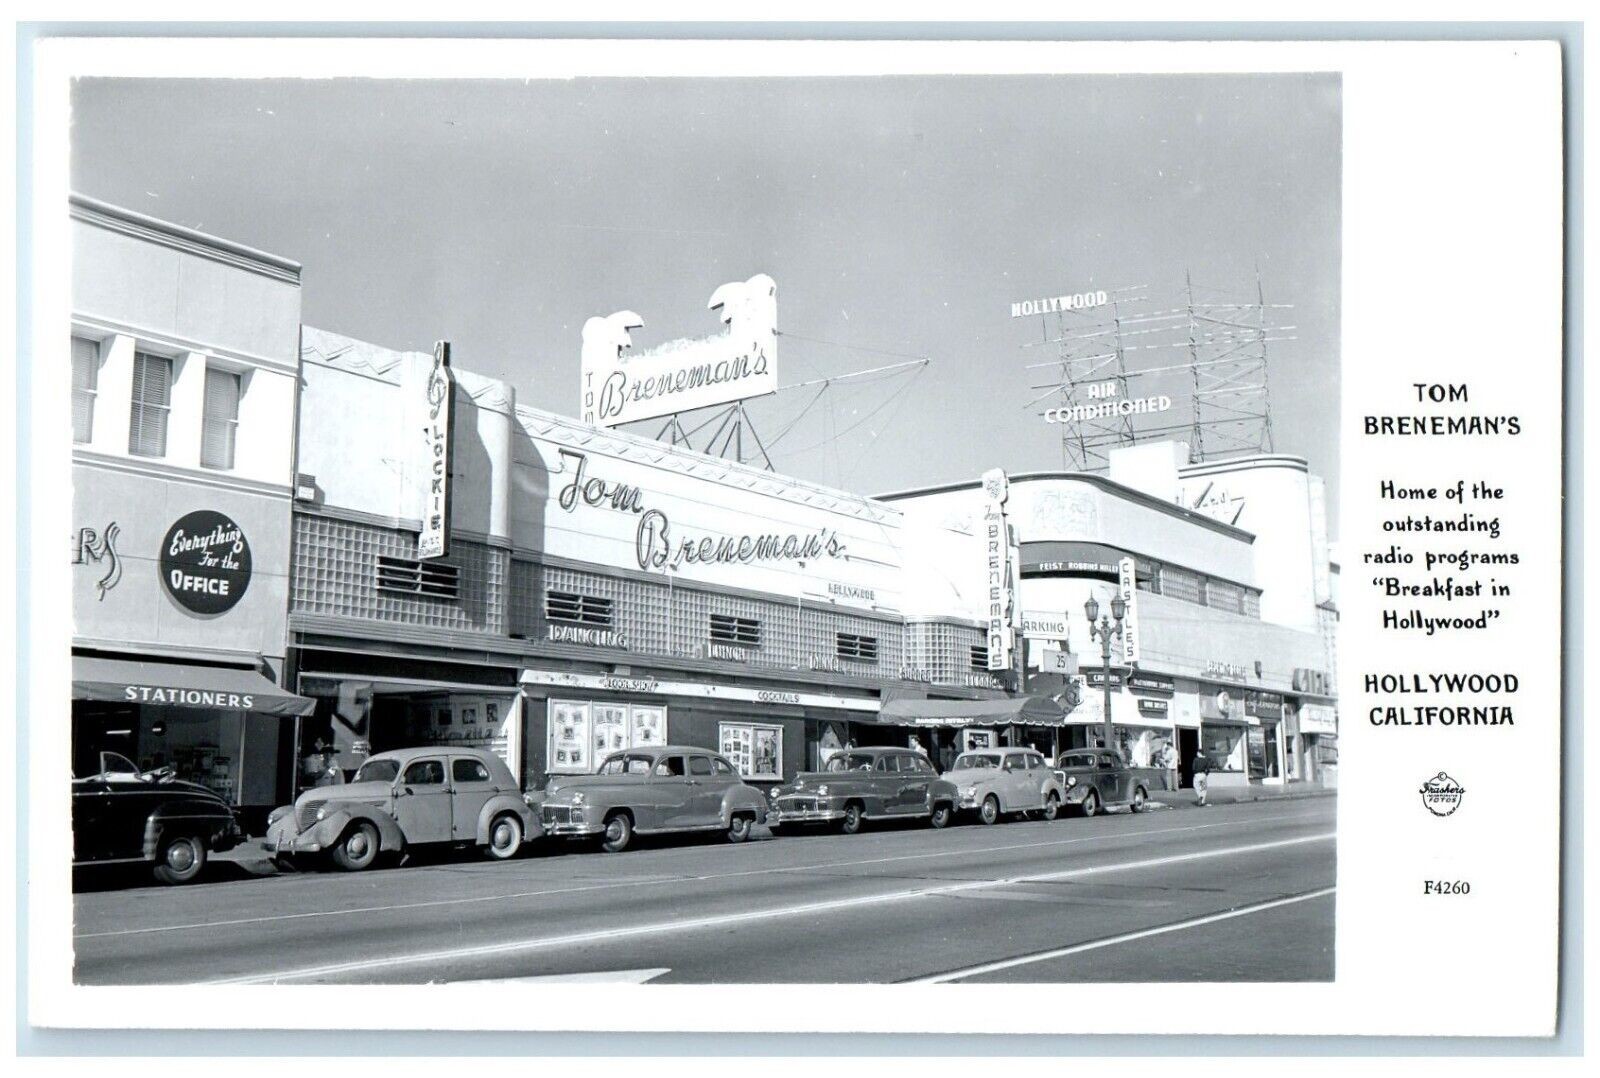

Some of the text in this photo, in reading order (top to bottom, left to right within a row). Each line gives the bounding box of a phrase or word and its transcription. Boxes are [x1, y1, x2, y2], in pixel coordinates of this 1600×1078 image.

[1011, 290, 1108, 318] HOLLYWOOD
[599, 341, 768, 420] Breneman's
[1087, 381, 1117, 400] AIR
[1044, 396, 1171, 424] CONDITIONED
[558, 447, 644, 514] Tom
[169, 523, 243, 557] Everything
[636, 508, 845, 570] Breneman's
[71, 521, 122, 601] RS
[198, 551, 239, 570] For the
[1040, 562, 1063, 570] FEIST
[170, 569, 230, 596] OFFICE
[548, 624, 628, 648] DANCING
[1023, 620, 1065, 633] ARKING
[124, 685, 254, 708] STATIONERS
[757, 690, 800, 703] COCKTAILS
